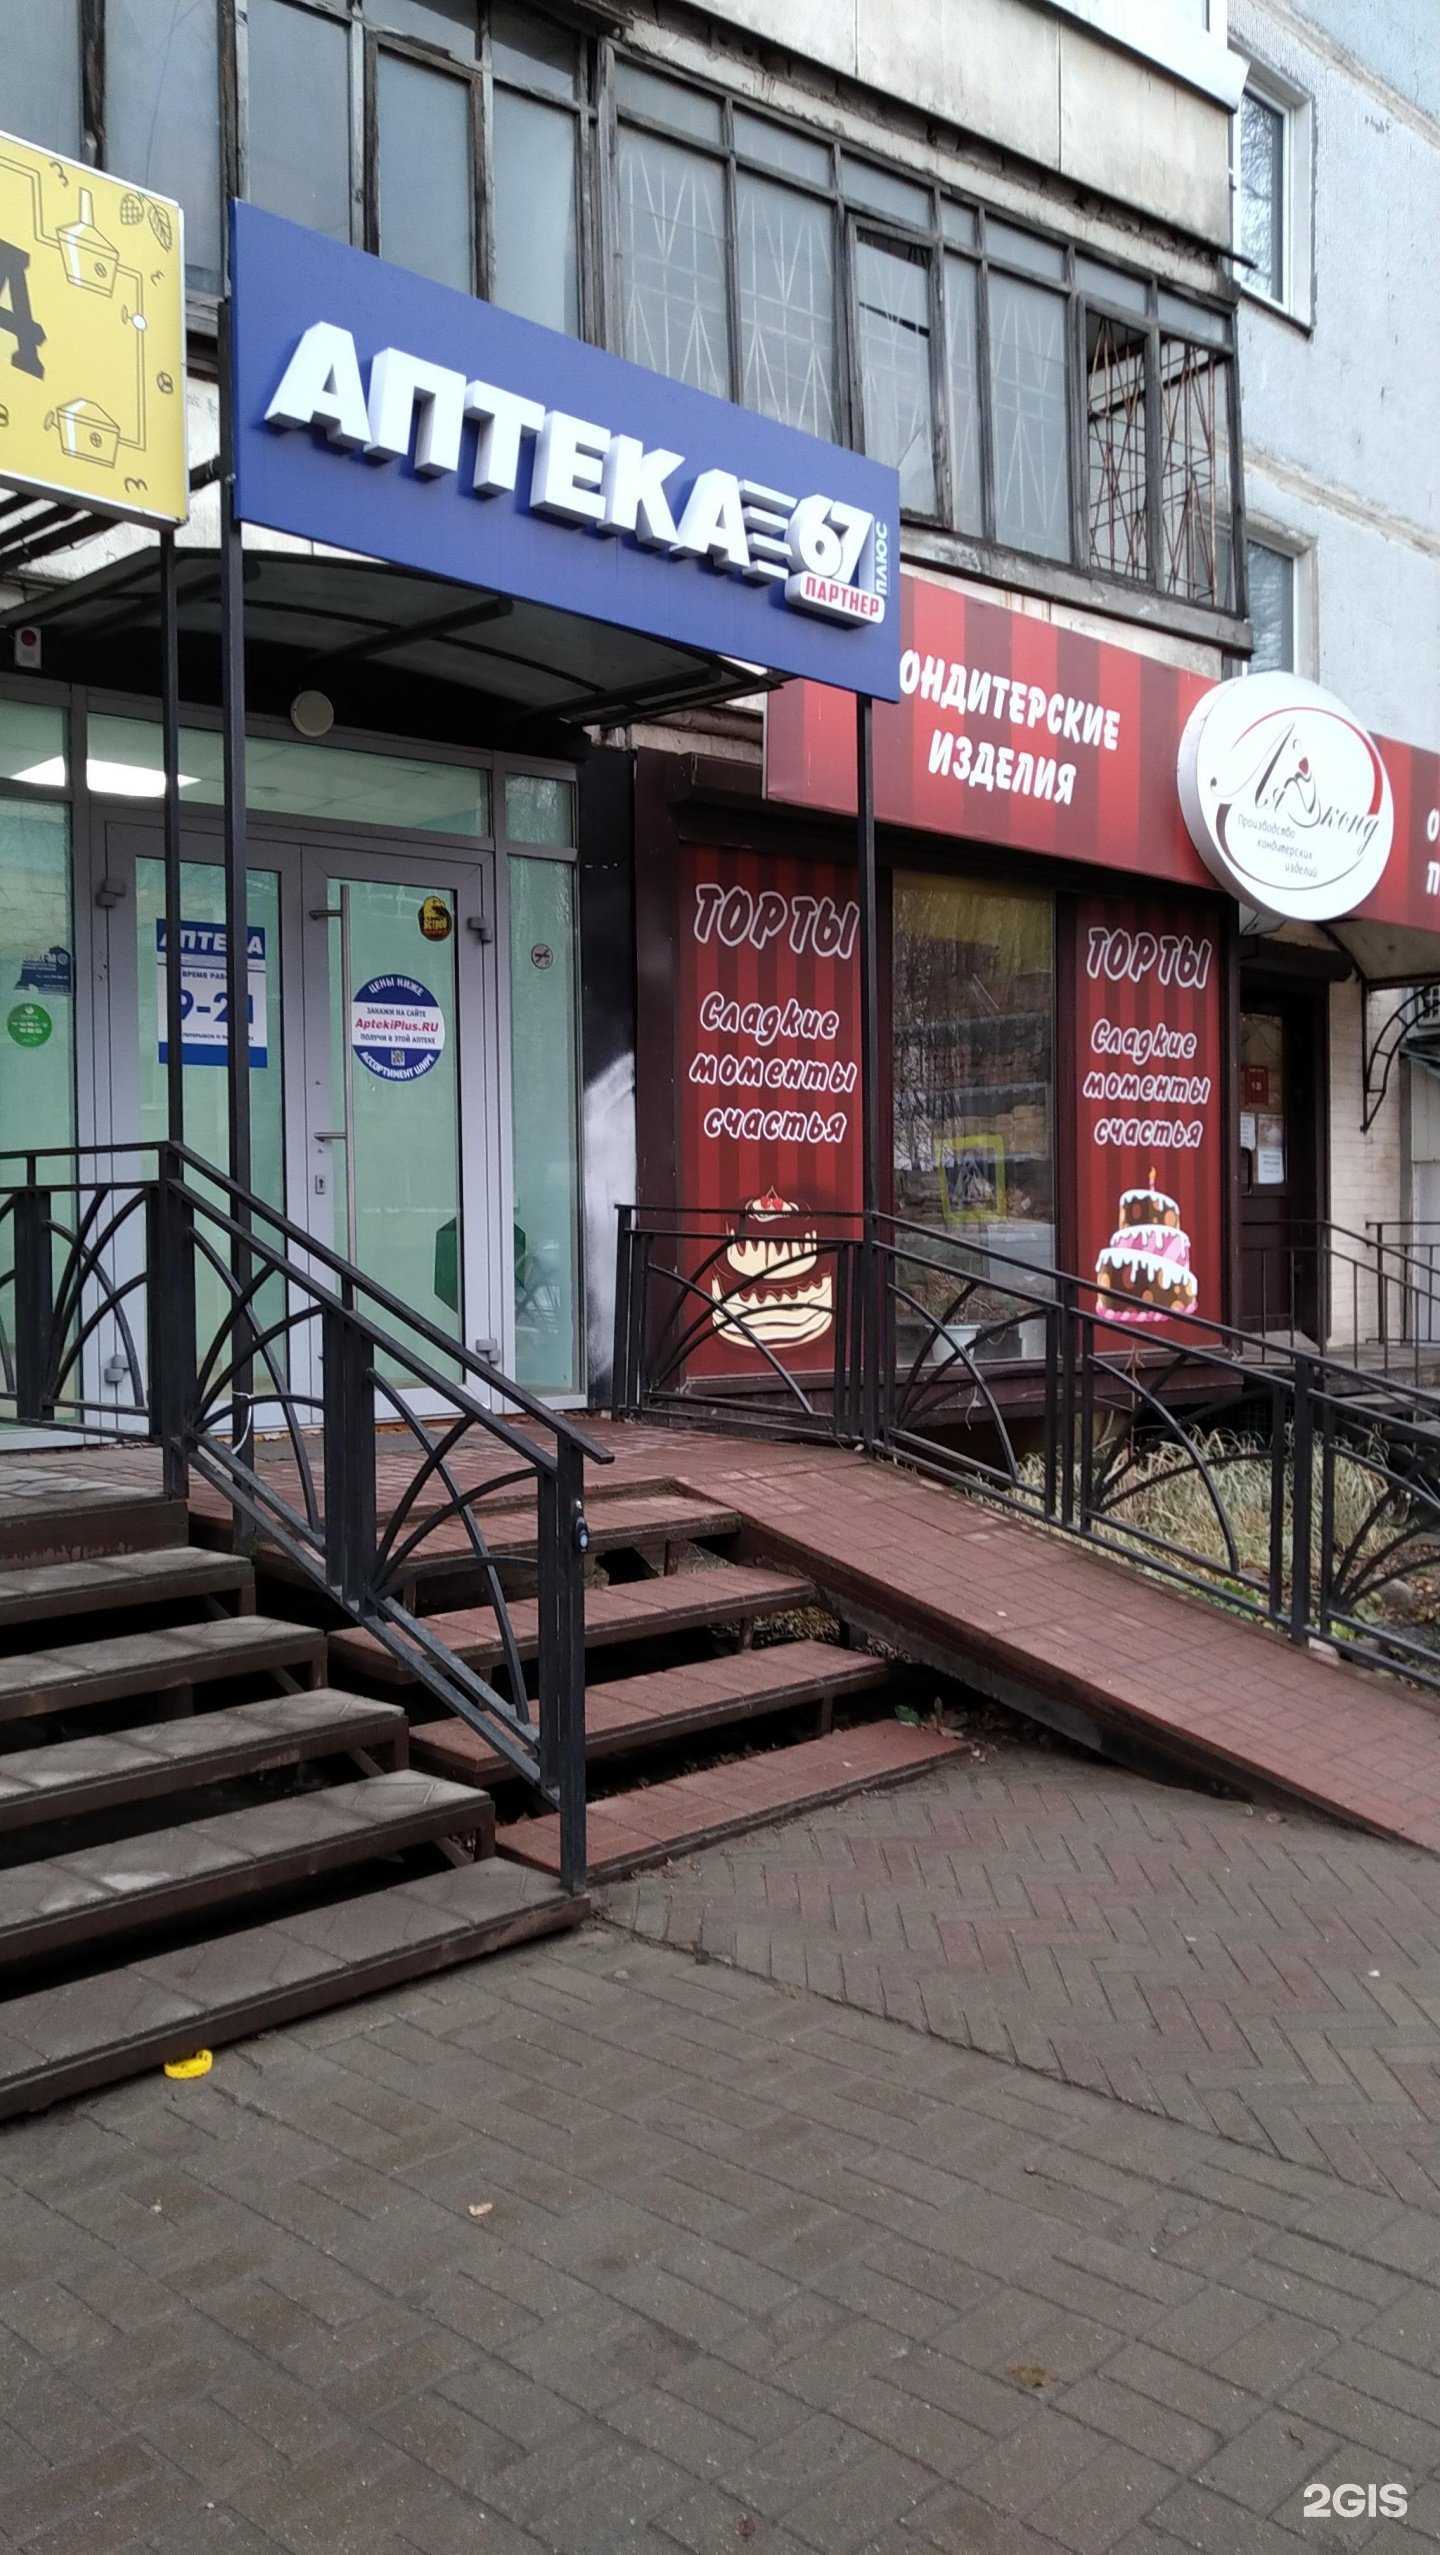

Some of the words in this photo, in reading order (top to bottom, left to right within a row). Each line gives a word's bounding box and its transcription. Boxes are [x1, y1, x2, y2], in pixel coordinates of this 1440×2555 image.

[264, 321, 751, 571] АПТЕКА
[785, 494, 875, 585] 67
[874, 521, 889, 596] ПЛЮС
[804, 574, 880, 617] ПАРТНЕР
[900, 649, 1121, 751] ОНДИТЕРСКИЕ
[928, 729, 1077, 806] ИЗДЕЛИЯ
[1237, 812, 1297, 840] Производство
[159, 929, 263, 955] ПТЕА
[694, 883, 860, 960] ТОРТЫ
[1086, 927, 1213, 989] ТОРТЫ
[368, 976, 395, 995] ЦЕНЫ
[355, 1017, 440, 1033] AptekiPlus.RU
[396, 1008, 405, 1017] НА
[700, 991, 840, 1047] Сладкие
[1091, 1018, 1197, 1066] Сладкие
[360, 1051, 414, 1079] АССОРТИМЕНТ
[689, 1052, 857, 1093] моменты
[1082, 1071, 1211, 1105] моменты
[704, 1107, 848, 1143] счастья
[1094, 1117, 1204, 1149] счастья
